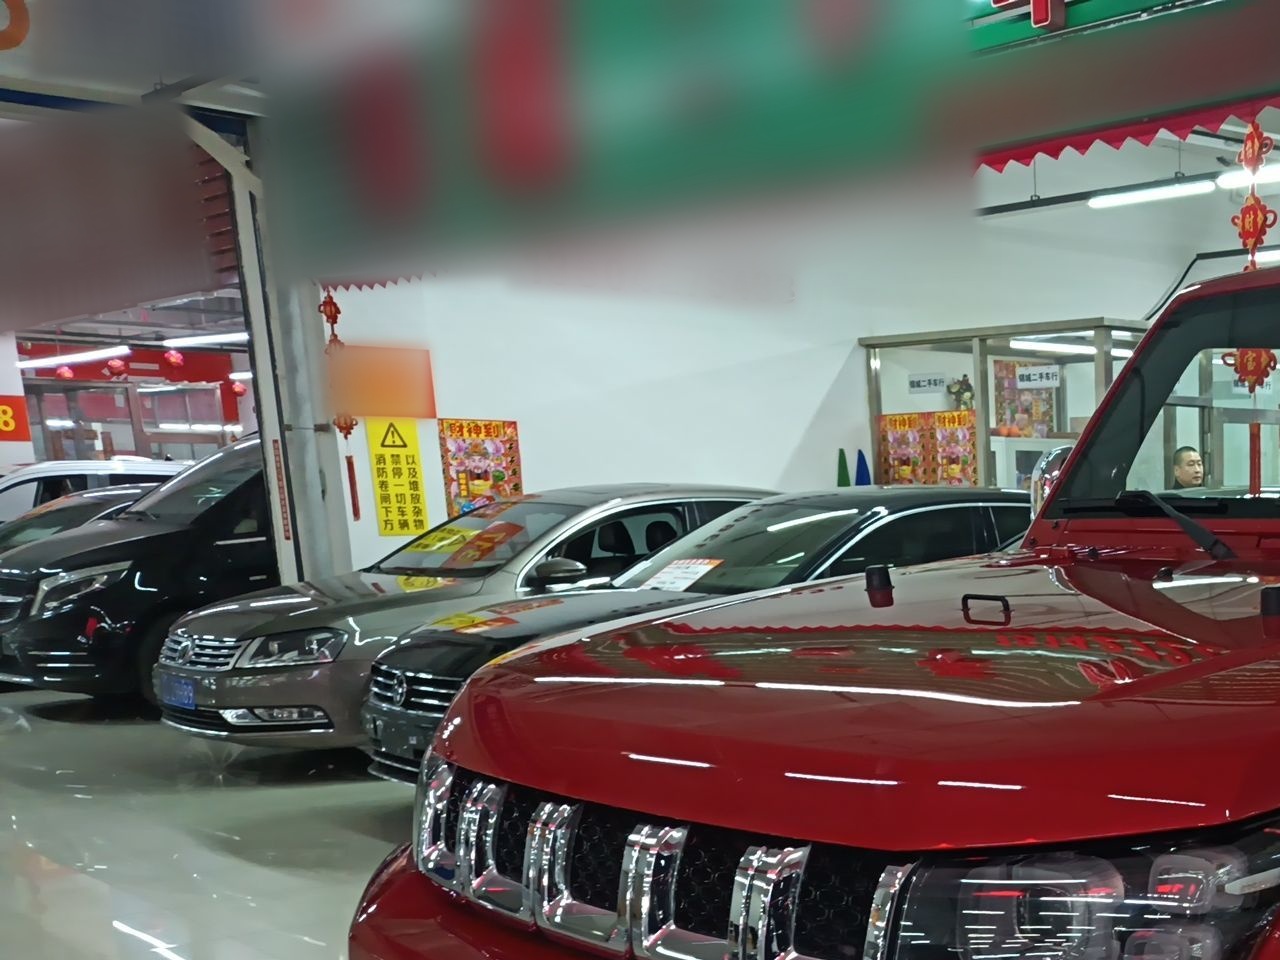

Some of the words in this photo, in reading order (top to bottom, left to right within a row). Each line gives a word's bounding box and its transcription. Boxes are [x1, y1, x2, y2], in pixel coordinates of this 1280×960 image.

[390, 453, 410, 531] 禁停一切车辆
[405, 454, 425, 530] 以及堆放杂物
